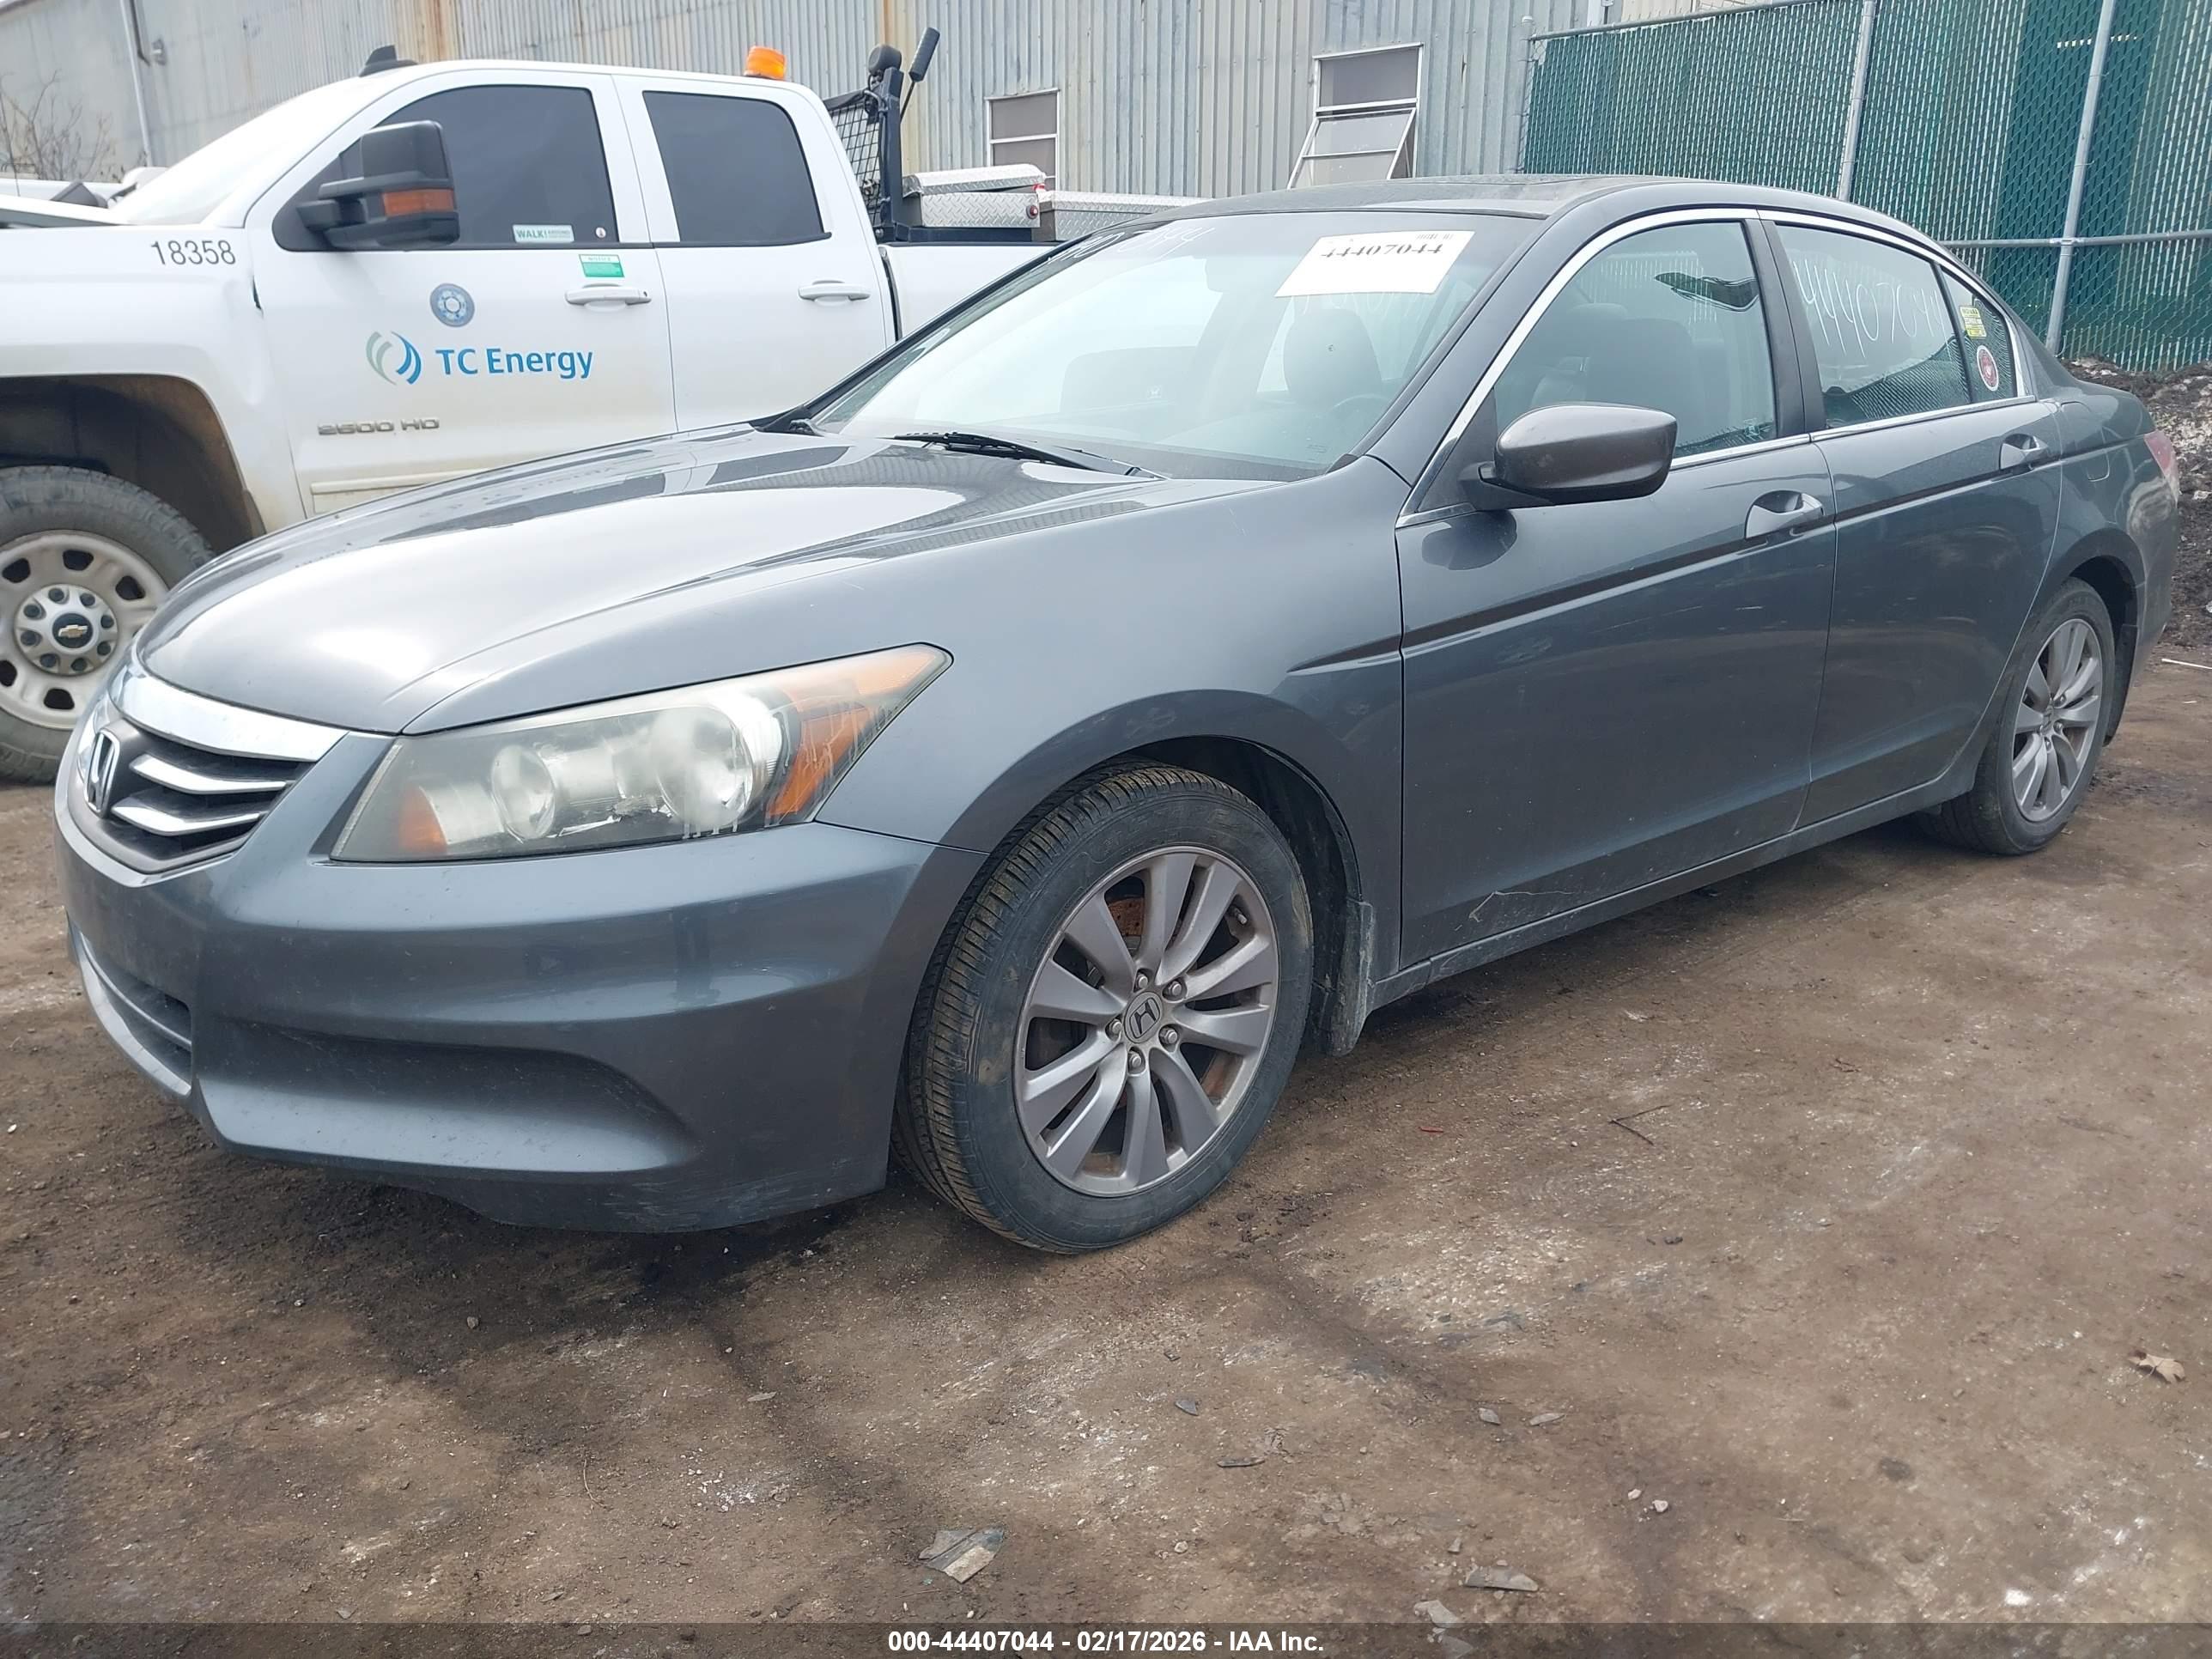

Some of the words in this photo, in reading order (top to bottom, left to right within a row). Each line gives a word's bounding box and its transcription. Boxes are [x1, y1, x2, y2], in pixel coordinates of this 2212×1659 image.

[151, 240, 236, 265] 18358
[1321, 243, 1443, 258] 44407044
[434, 348, 479, 375] TC
[486, 348, 593, 380] Energy
[401, 418, 441, 431] HD
